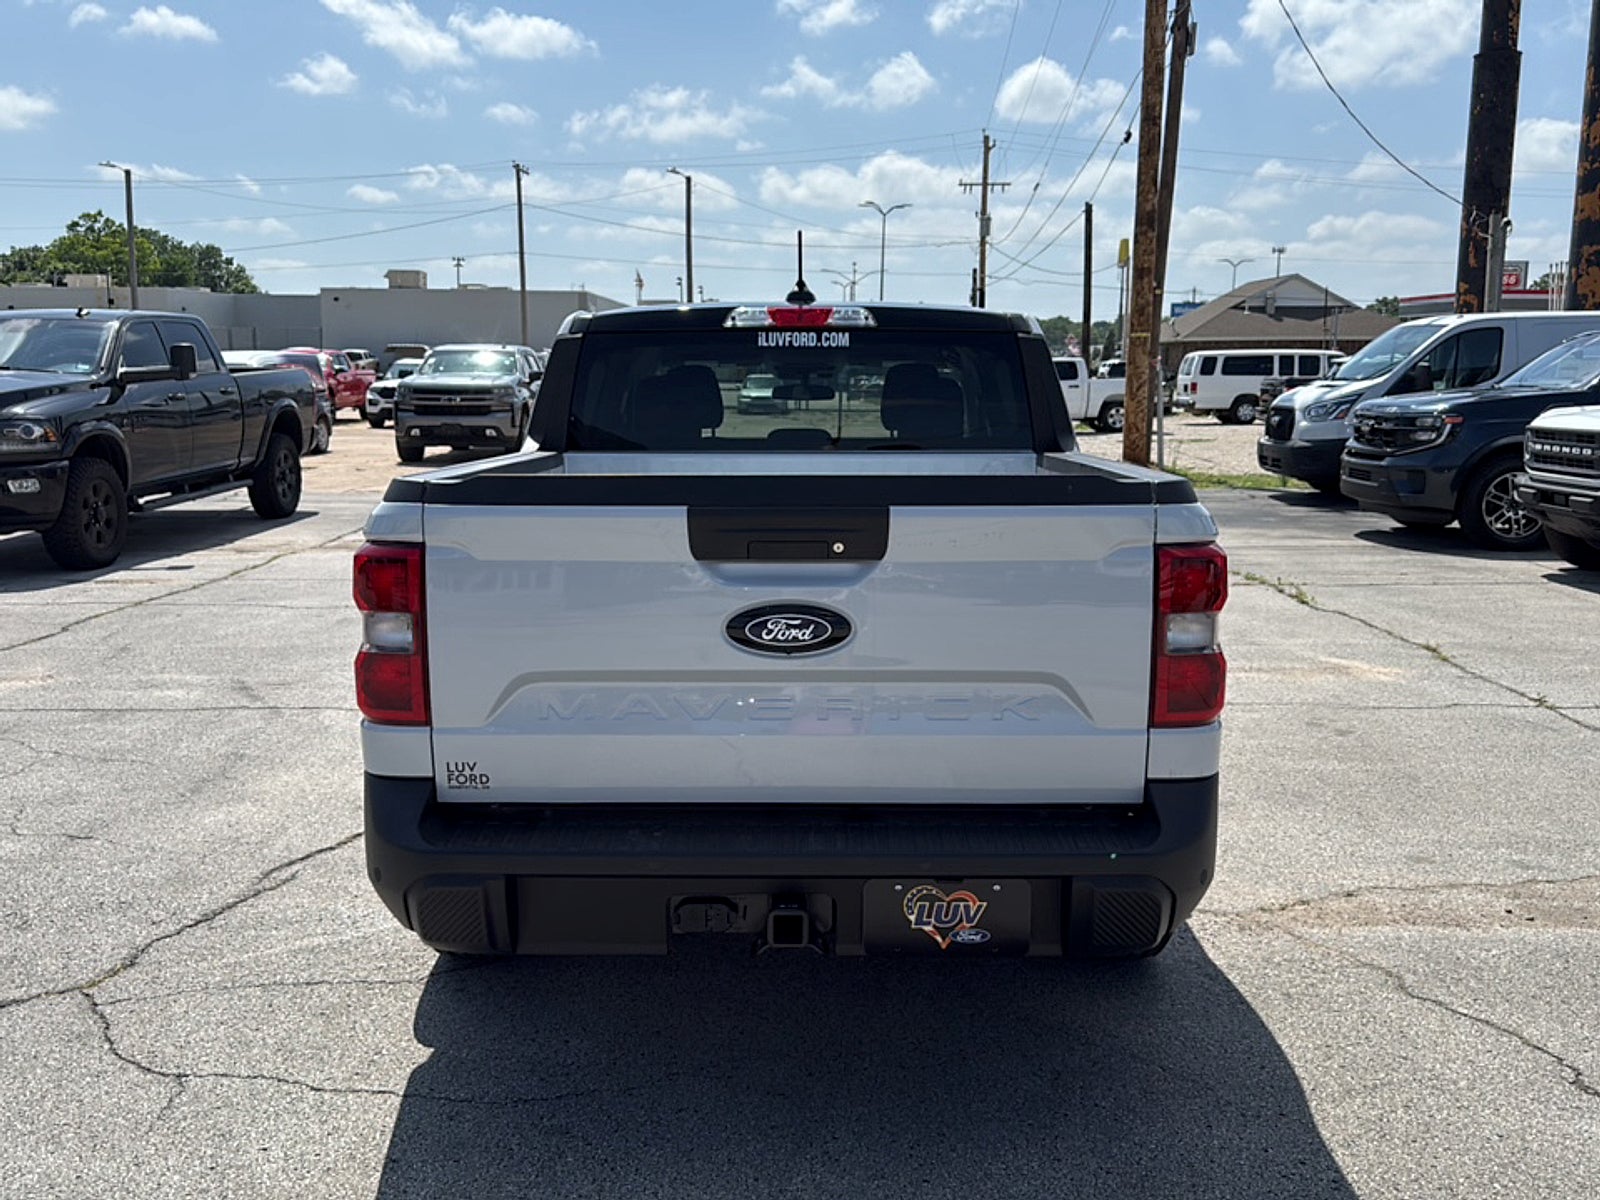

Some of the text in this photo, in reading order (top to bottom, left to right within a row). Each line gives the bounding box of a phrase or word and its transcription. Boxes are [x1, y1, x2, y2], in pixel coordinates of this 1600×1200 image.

[758, 332, 850, 347] iLUVFORD.COM
[1535, 443, 1592, 455] BRONCO
[762, 619, 815, 640] Ford
[537, 695, 1041, 722] MAVERICK
[446, 761, 477, 773] LUV
[447, 773, 490, 785] FORD
[912, 902, 987, 928] LUV
[957, 931, 982, 942] Ford
